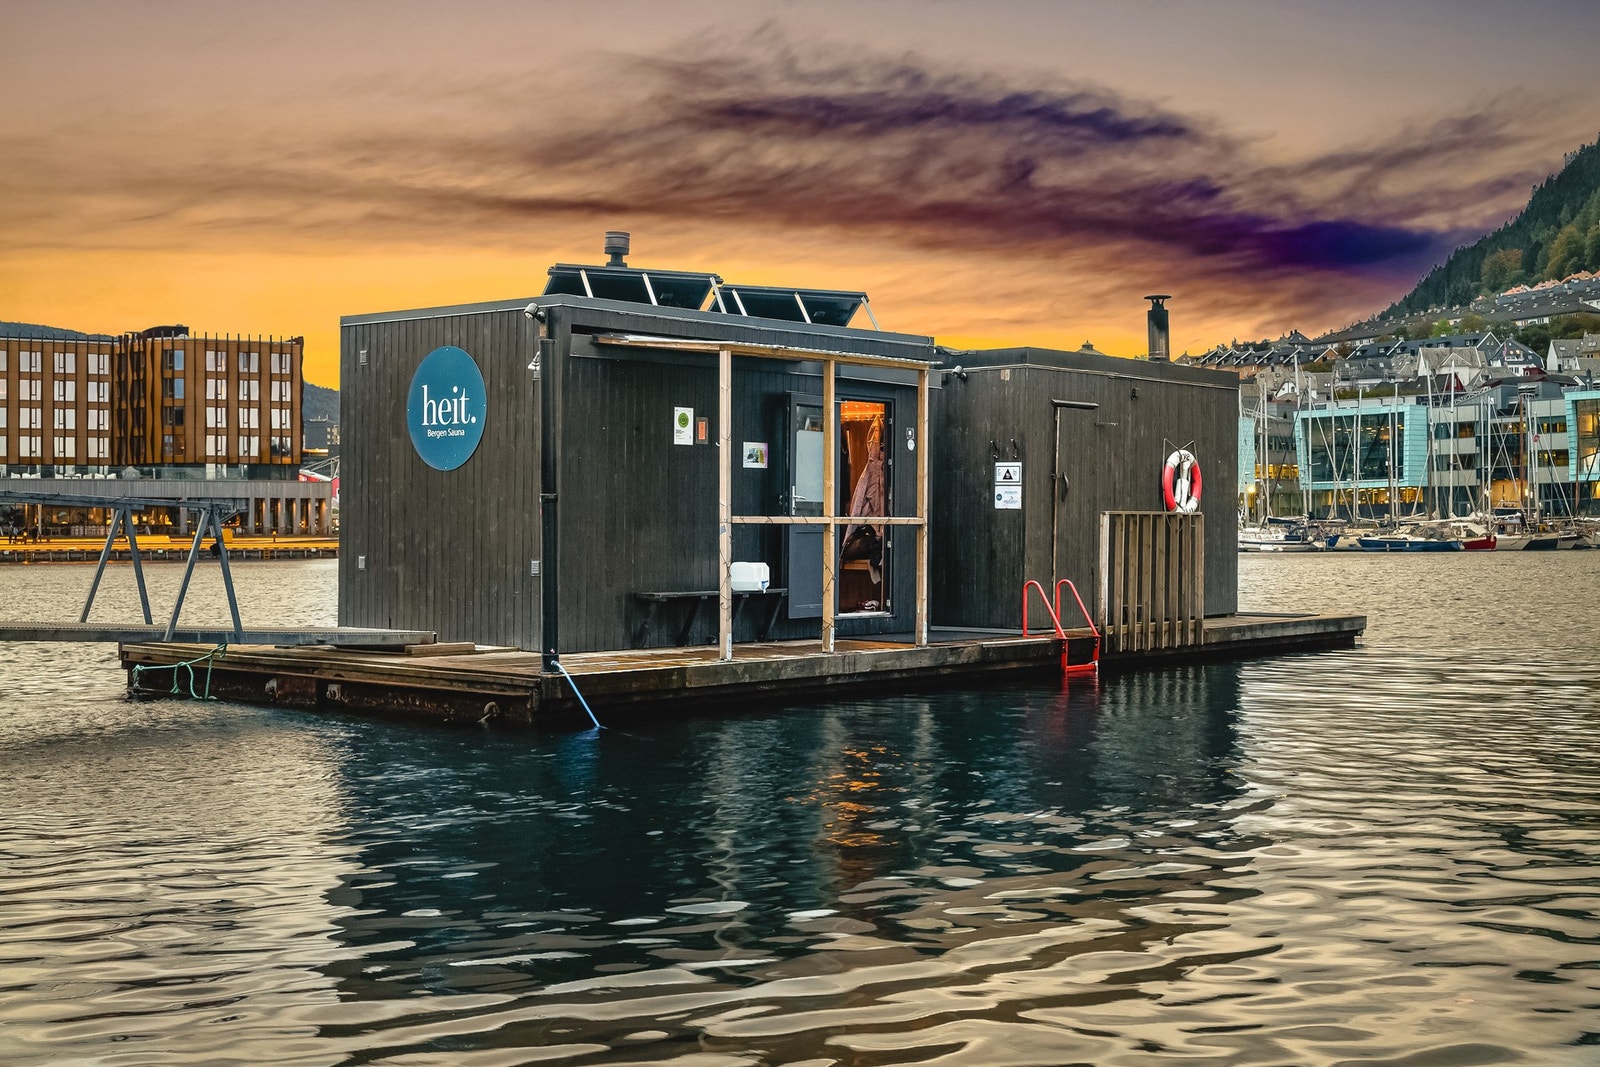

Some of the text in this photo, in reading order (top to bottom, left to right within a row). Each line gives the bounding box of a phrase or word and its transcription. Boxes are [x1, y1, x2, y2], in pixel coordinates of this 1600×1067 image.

[421, 384, 477, 426] heit.
[427, 427, 465, 439] Bergen Sauna
